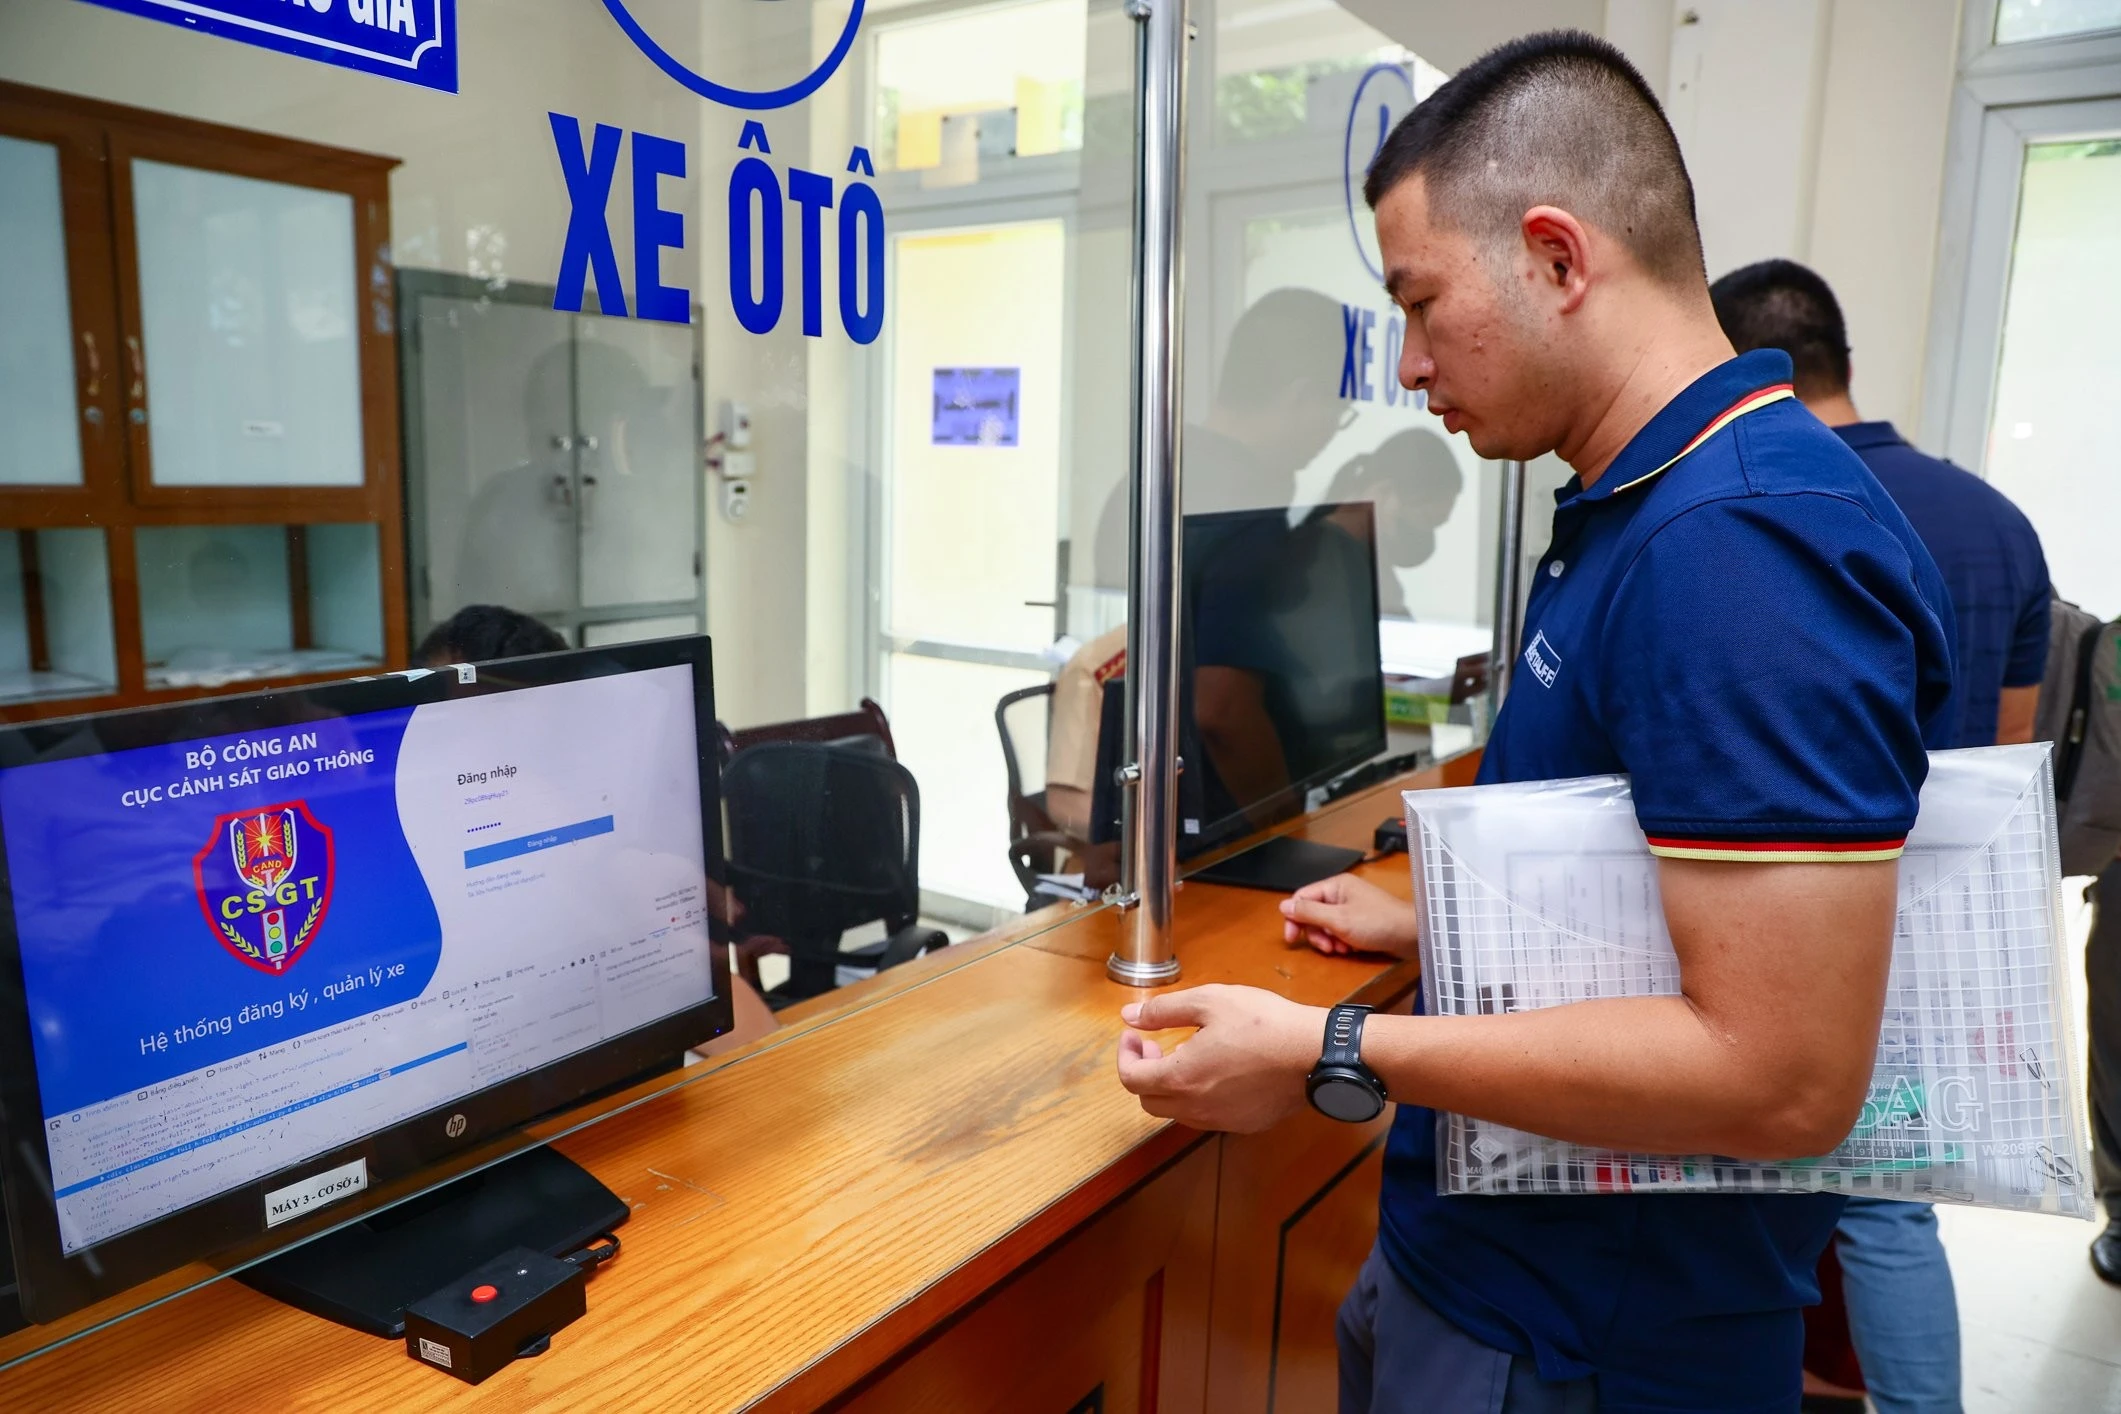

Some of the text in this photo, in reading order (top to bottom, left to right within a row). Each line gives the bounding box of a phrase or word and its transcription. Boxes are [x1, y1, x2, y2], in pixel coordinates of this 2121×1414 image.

[547, 111, 885, 345] XE ÔTÔ
[1339, 303, 1376, 401] XE
[185, 732, 317, 770] BỘ CÔNG AN
[121, 749, 375, 808] CỤC CẢNH SÁT GIAO THÔNG
[457, 765, 517, 785] Đăng nhập
[252, 860, 282, 873] CAND
[221, 876, 318, 919] CSGT
[140, 1031, 168, 1055] Hệ
[174, 1017, 232, 1044] thống
[237, 1000, 284, 1025] đăng
[288, 987, 310, 1011] ký
[323, 973, 365, 1001] quản
[368, 965, 384, 988] lý
[387, 962, 406, 979] xe
[448, 1114, 466, 1138] hp
[272, 1197, 300, 1216] MÁY
[302, 1194, 310, 1205] 3
[318, 1183, 335, 1198] CƠ
[336, 1177, 352, 1194] SỞ
[353, 1175, 360, 1185] 4
